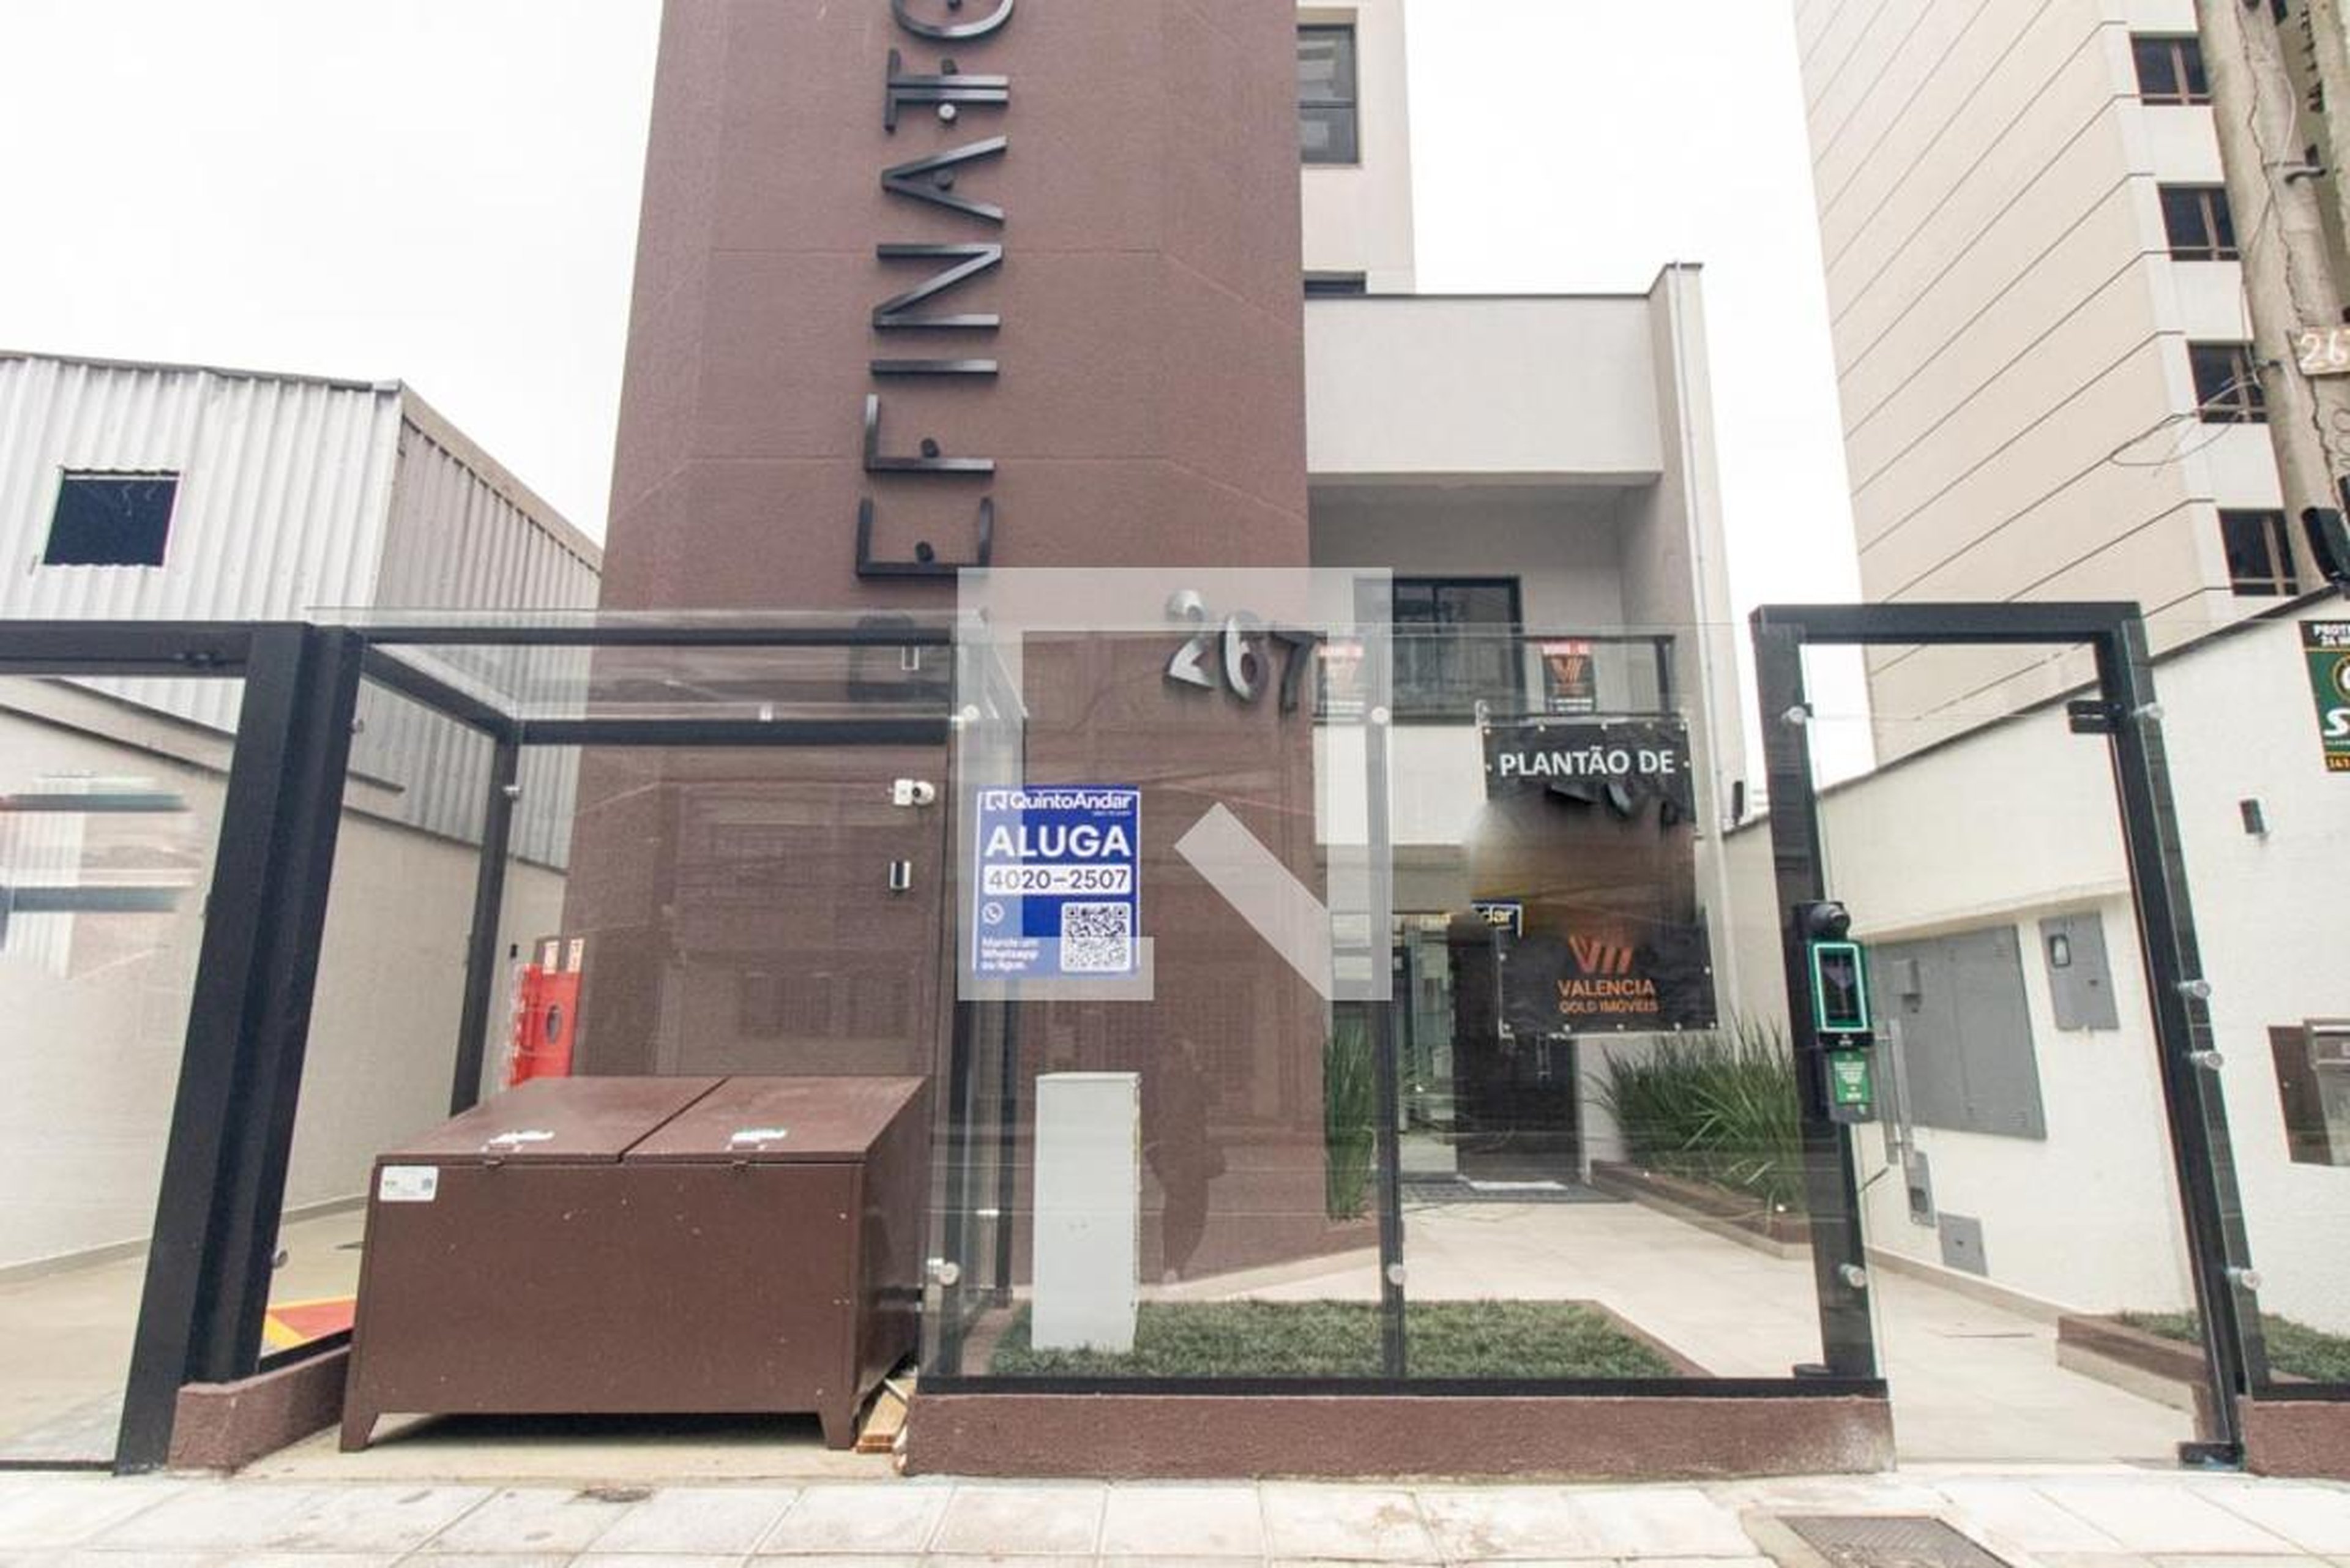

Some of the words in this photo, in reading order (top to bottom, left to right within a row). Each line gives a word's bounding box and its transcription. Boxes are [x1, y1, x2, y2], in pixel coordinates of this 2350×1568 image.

[2299, 328, 2350, 369] 26
[1164, 589, 1322, 714] 267
[1499, 746, 1630, 777] PLANTÃO
[1639, 750, 1676, 774] DE
[1010, 792, 1132, 810] QuintoAndar
[985, 825, 1132, 857] ALUGA
[988, 869, 1128, 890] 4020-2507
